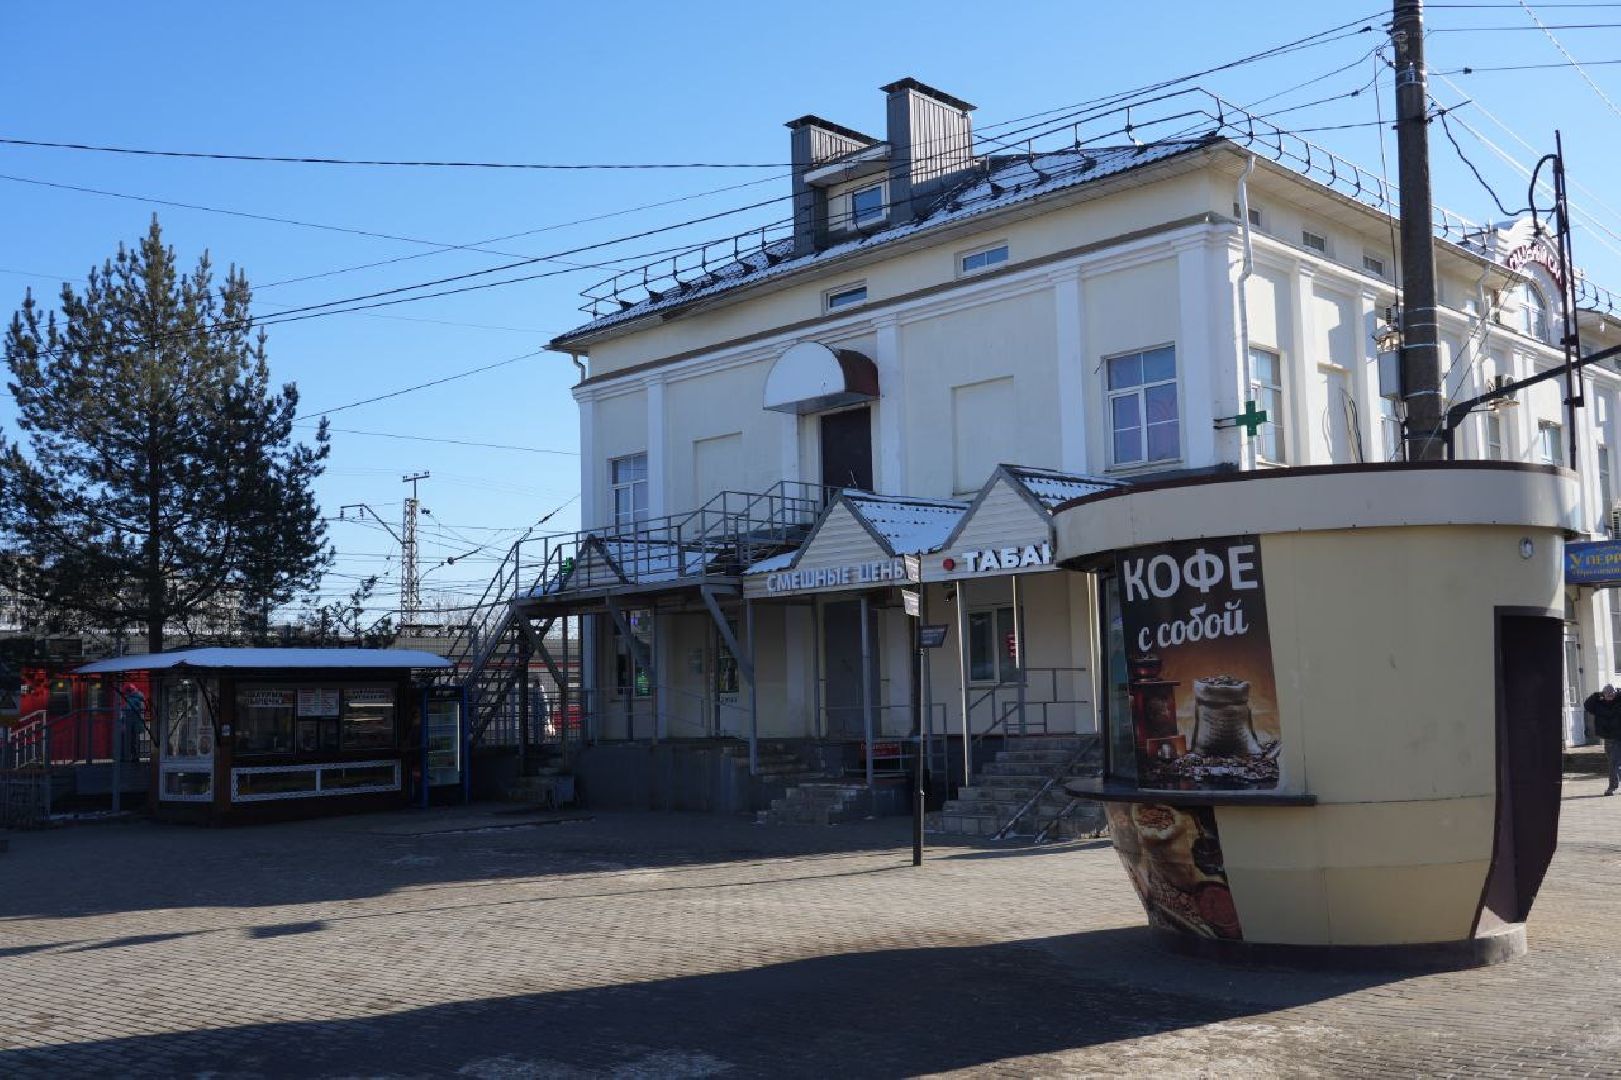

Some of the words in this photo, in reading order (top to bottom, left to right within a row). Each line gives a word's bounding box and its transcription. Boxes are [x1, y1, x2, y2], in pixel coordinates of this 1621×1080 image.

[766, 566, 849, 592] СМЕШНЫЕ
[1123, 544, 1258, 602] КОФЕ
[1138, 626, 1153, 652] с
[1157, 599, 1249, 648] собой
